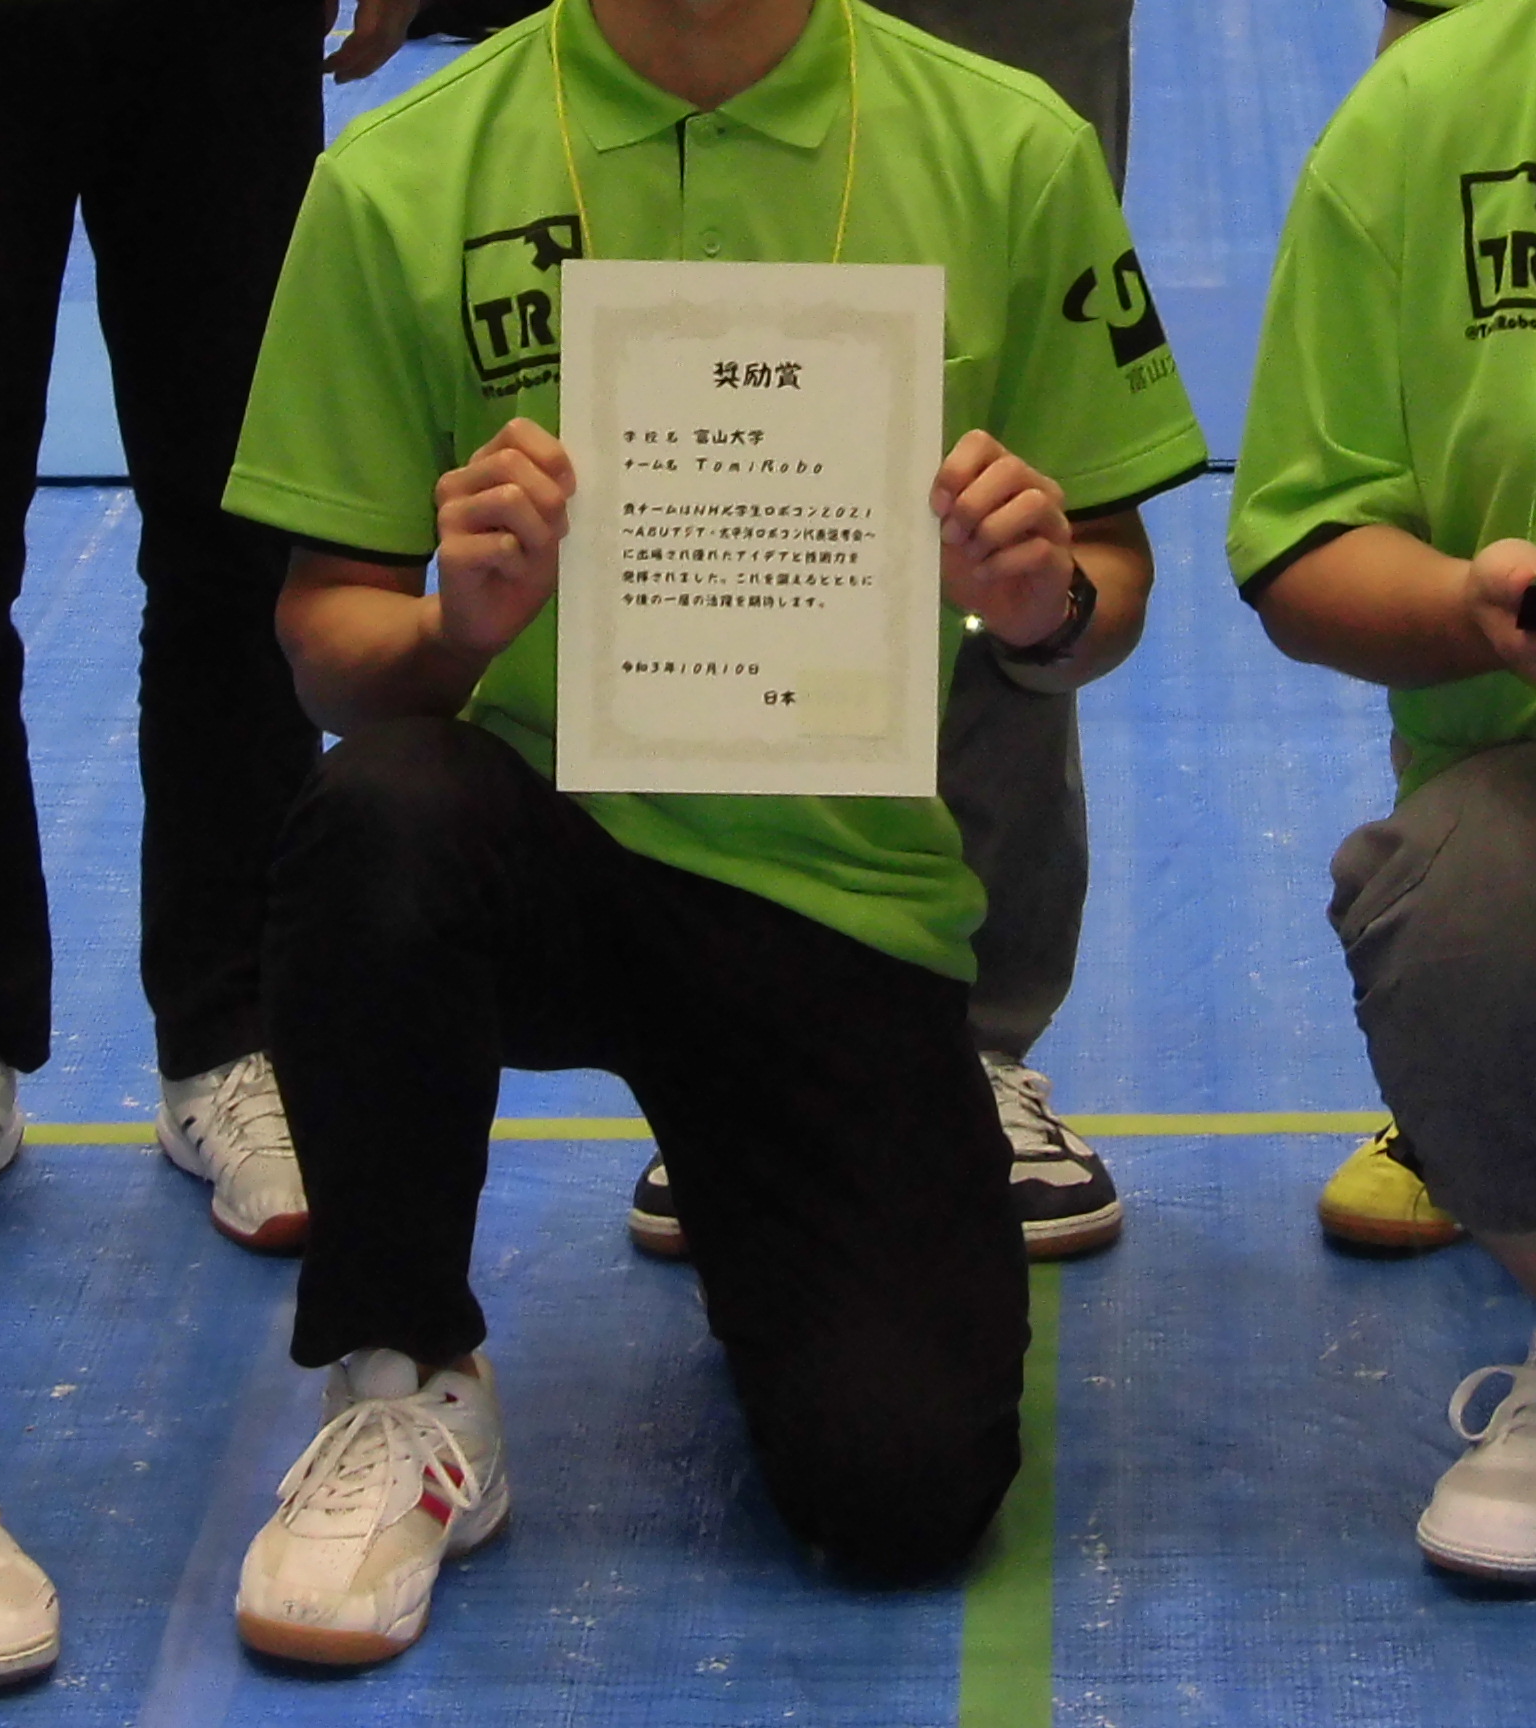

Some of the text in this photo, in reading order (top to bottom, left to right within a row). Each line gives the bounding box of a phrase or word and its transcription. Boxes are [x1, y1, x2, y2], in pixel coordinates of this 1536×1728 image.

[474, 289, 555, 358] TR
[713, 361, 802, 390] 奨励賞
[693, 428, 765, 446] 富山大学
[623, 458, 678, 472] チーム名
[763, 690, 797, 706] 日本
